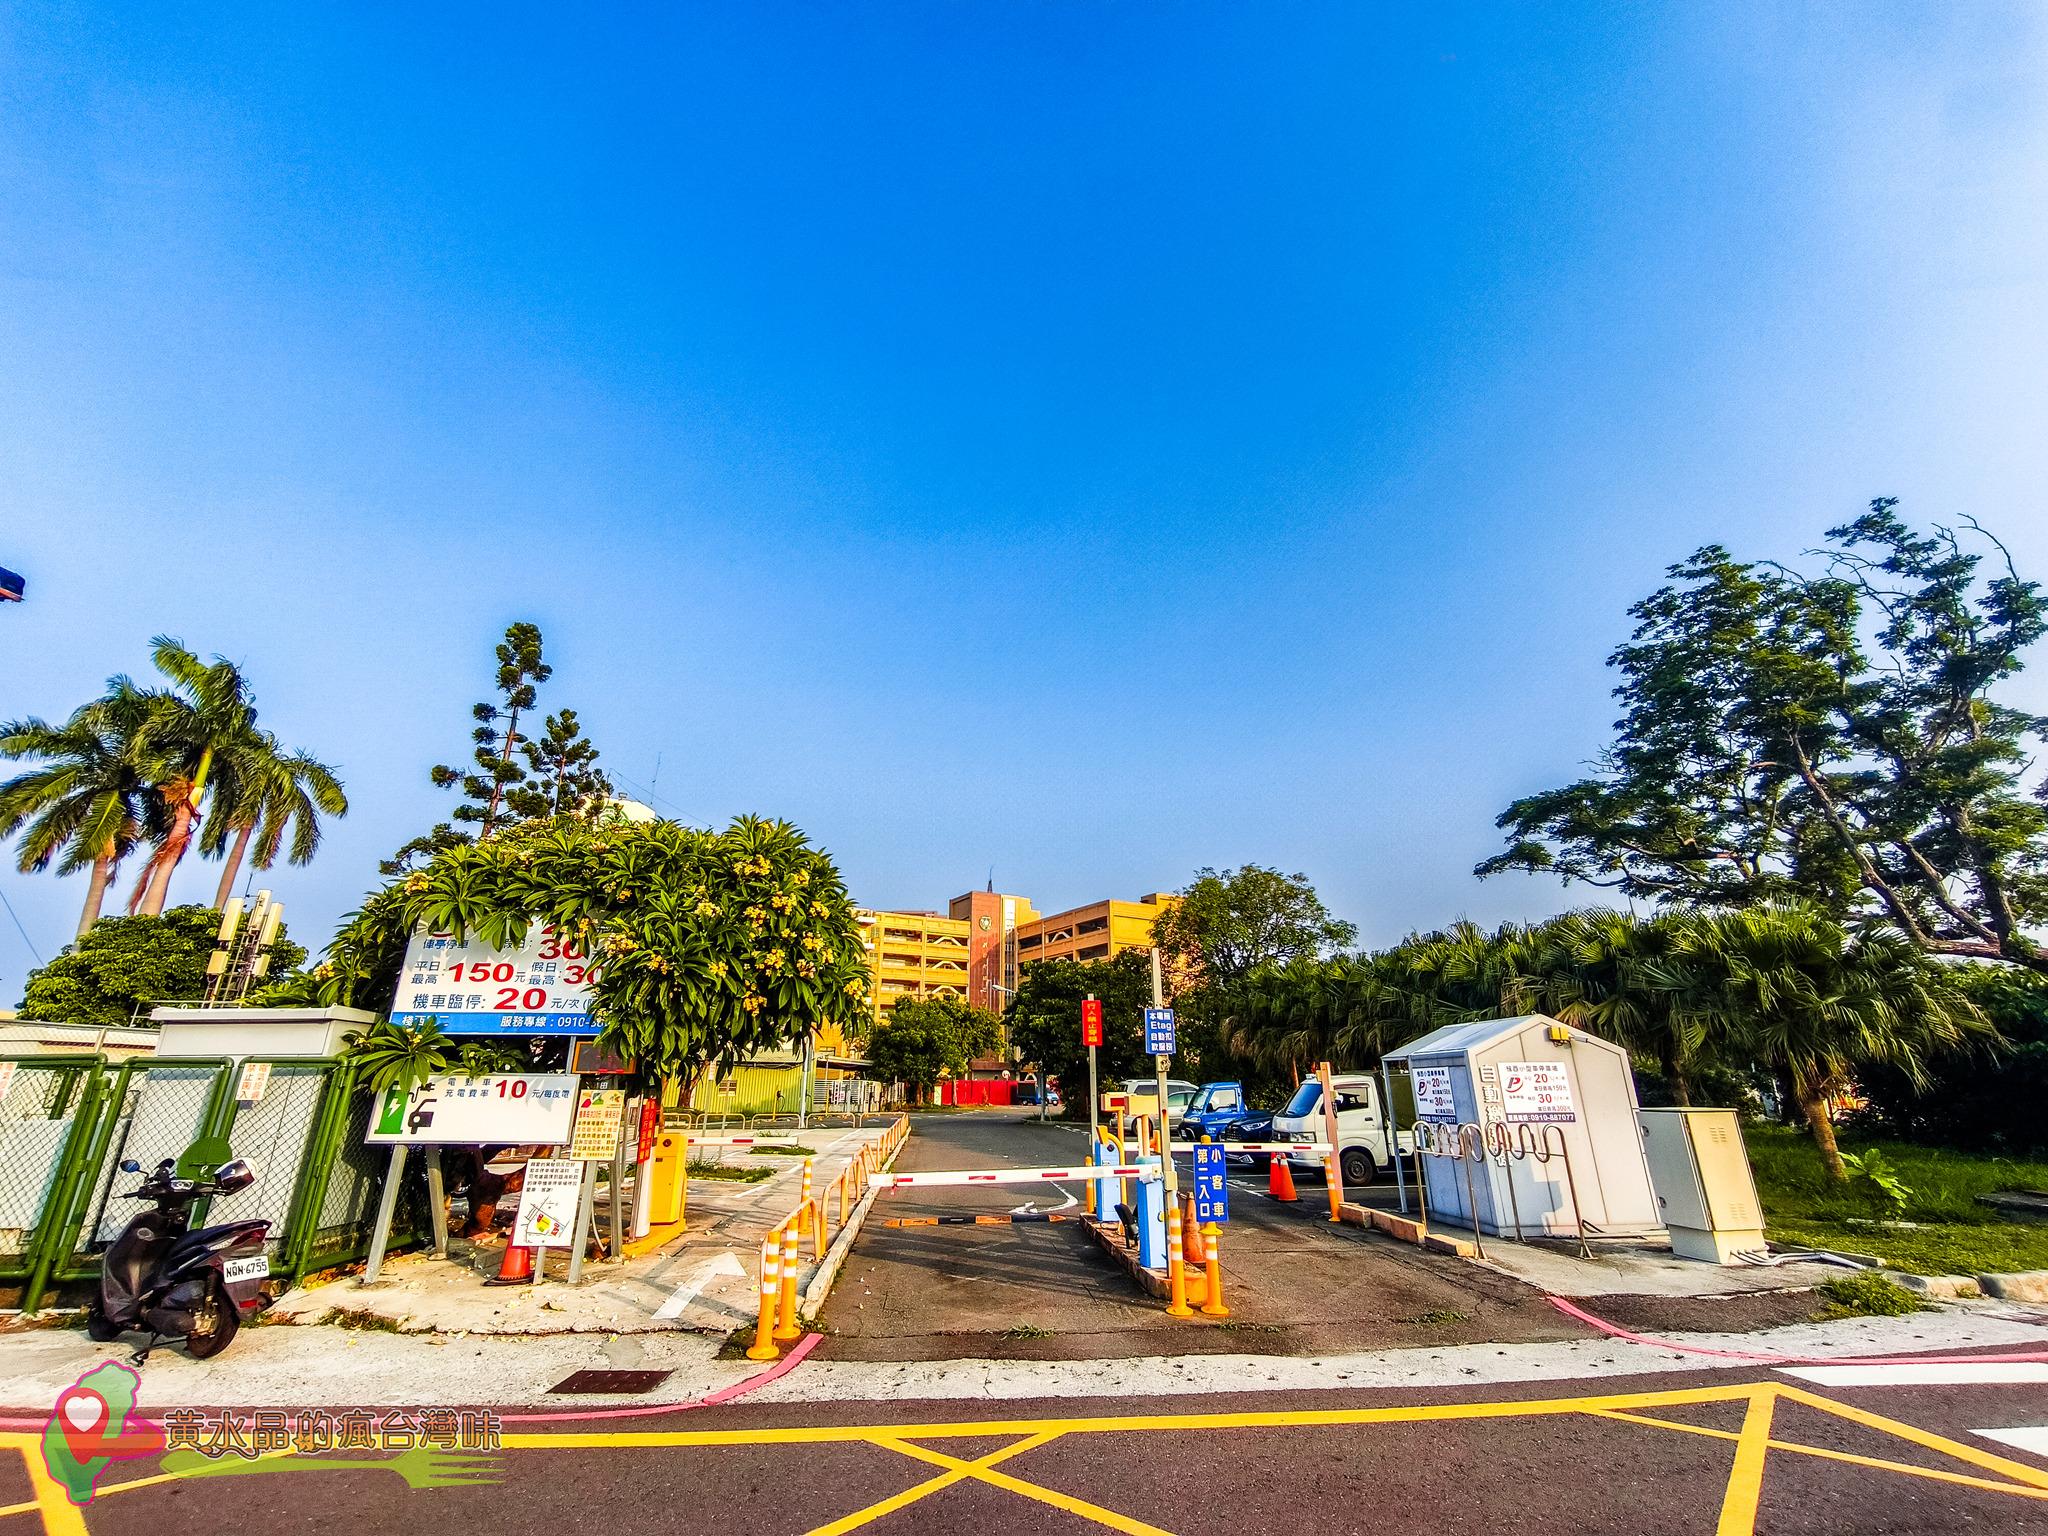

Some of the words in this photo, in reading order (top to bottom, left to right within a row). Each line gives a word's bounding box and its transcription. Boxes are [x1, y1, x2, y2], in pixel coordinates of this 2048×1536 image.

[415, 960, 440, 972] 平日
[531, 961, 557, 973] 假日
[411, 973, 437, 985] 最高
[448, 962, 515, 983] 150
[528, 974, 556, 986] 最高
[493, 987, 547, 1010] 20
[1150, 1021, 1172, 1031] Etag
[1431, 1077, 1440, 1088] 20
[1533, 1073, 1548, 1083] 20
[495, 1079, 528, 1099] 10
[1434, 1096, 1444, 1107] 30
[1537, 1093, 1552, 1103] 30
[1197, 1148, 1211, 1217] 第二入口
[1211, 1148, 1225, 1217] 小客車
